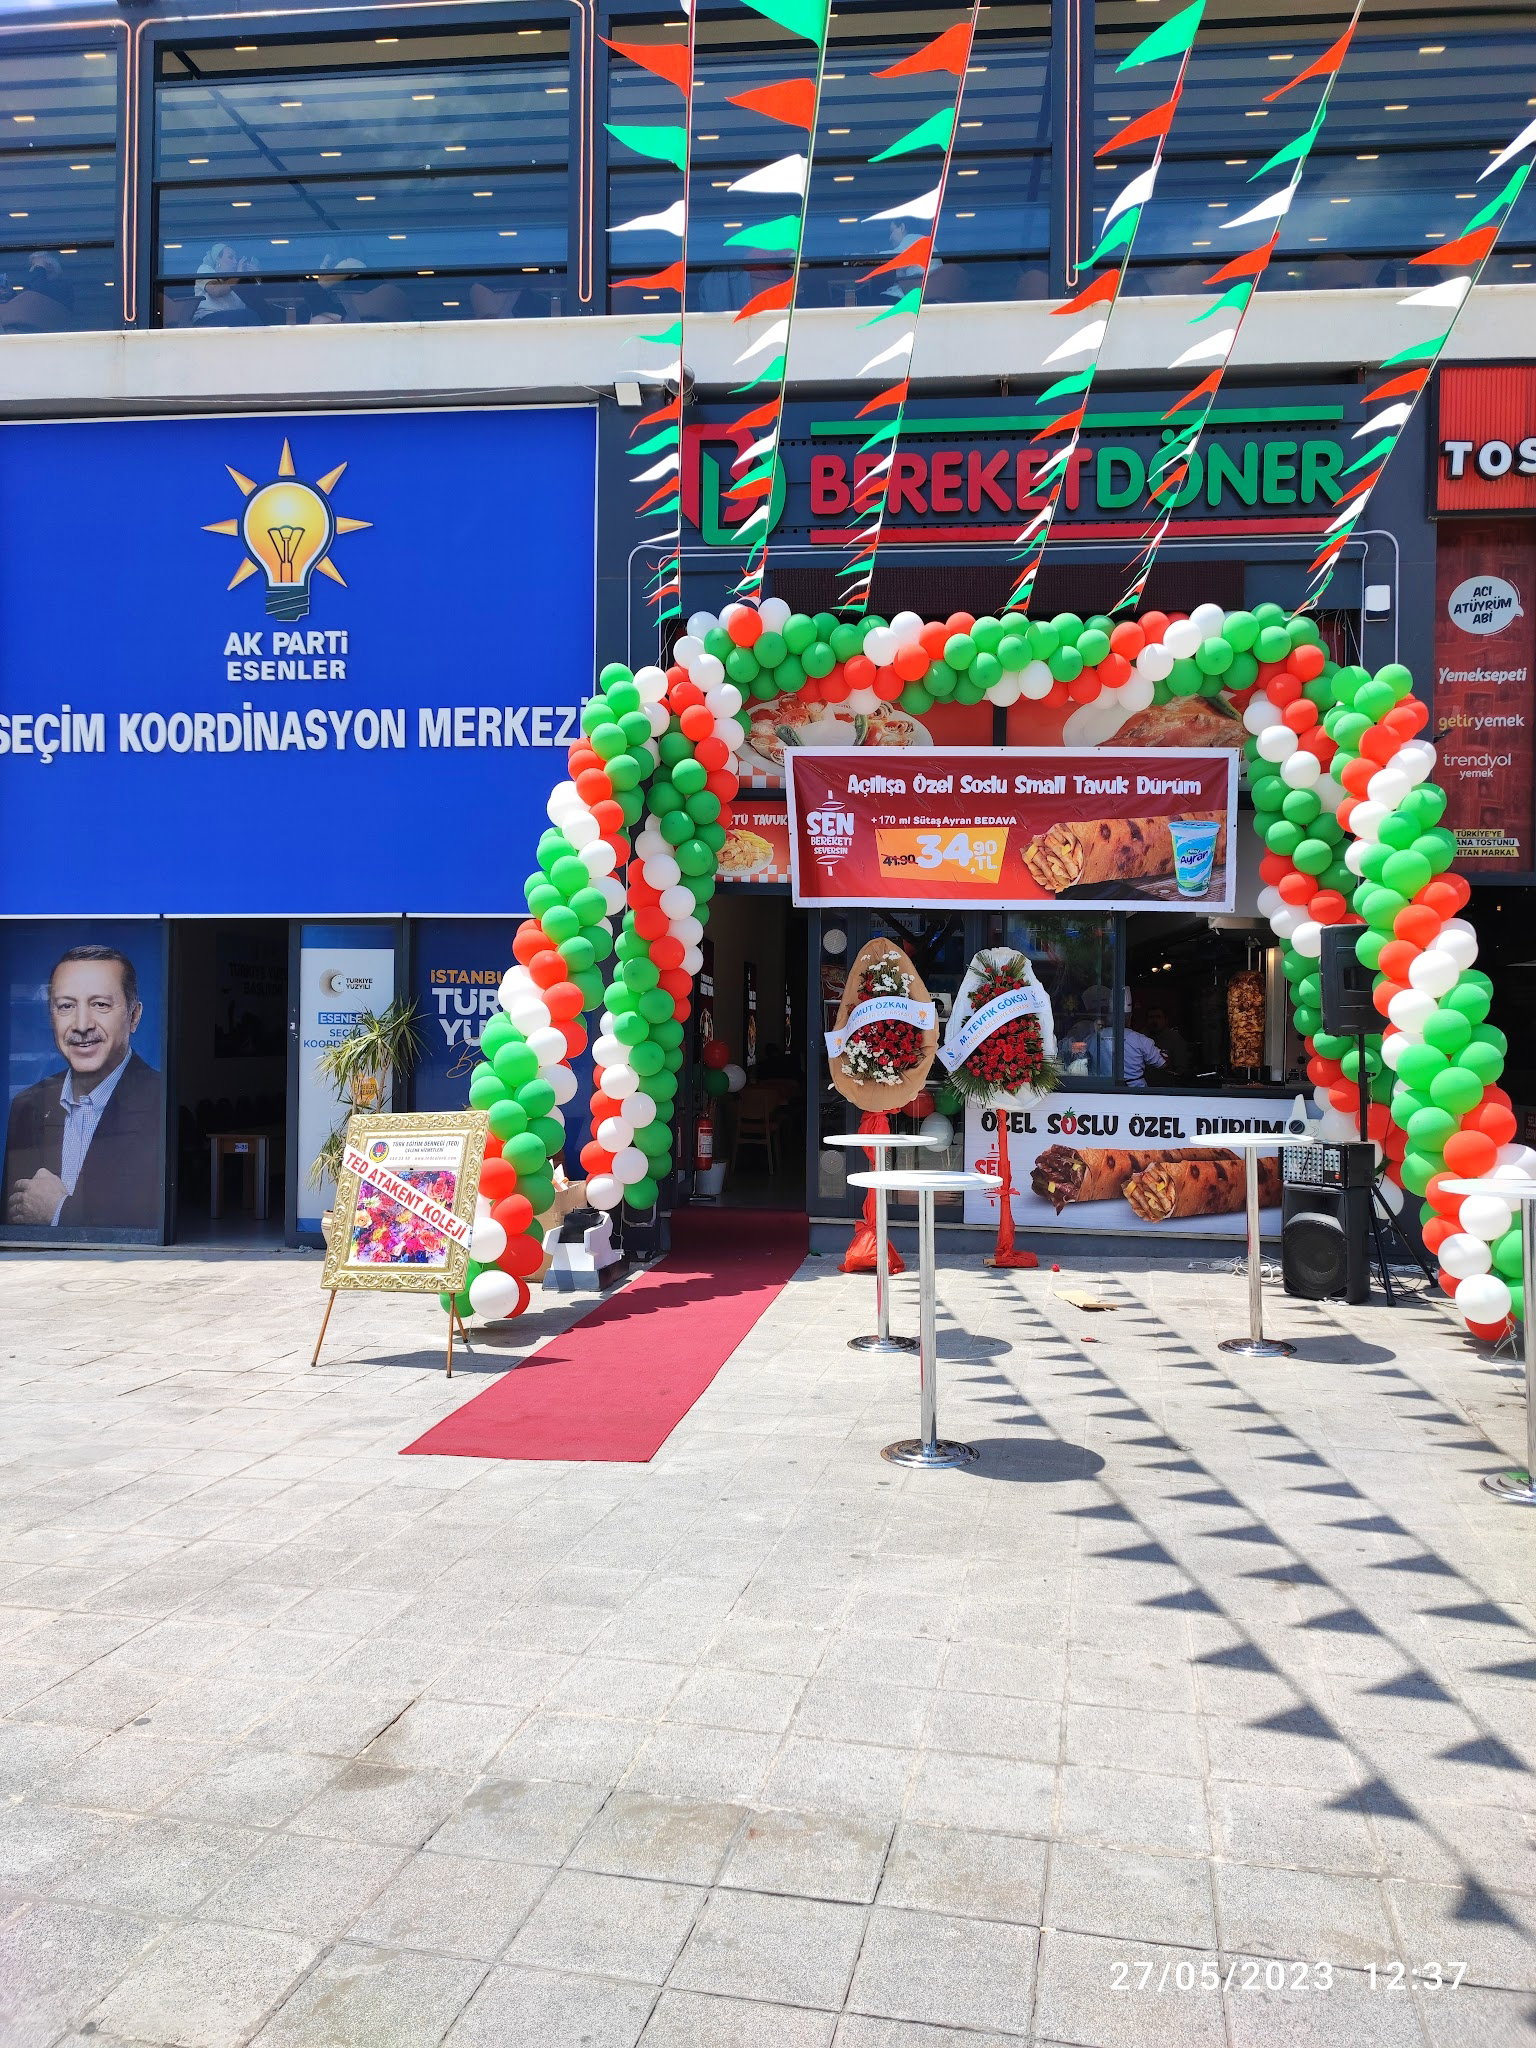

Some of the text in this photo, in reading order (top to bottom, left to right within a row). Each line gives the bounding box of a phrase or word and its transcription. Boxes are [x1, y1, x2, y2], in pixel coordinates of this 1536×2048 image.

[1473, 585, 1492, 598] ACI
[1453, 595, 1513, 615] ATÜYRÜM
[1472, 610, 1493, 625] ABİ
[223, 632, 263, 656] AK
[227, 659, 346, 681] ESENLER
[1438, 666, 1528, 685] Yemeksepeti
[119, 702, 405, 753] KOORDİNASYON
[1443, 752, 1512, 769] trendyol
[1460, 768, 1494, 781] yemek
[847, 772, 1202, 797] Açılışa Özel Soslu Small Tavuk Dürüm
[806, 811, 855, 836] SEN
[899, 816, 911, 825] ml
[974, 816, 1017, 825] BEDAVA
[1456, 829, 1502, 838] TÜRKİYE'YE
[1457, 838, 1515, 846] ANA TOSTUNU
[975, 856, 998, 870] TL
[875, 1001, 909, 1011] ÖZKAN
[320, 1013, 363, 1024] ESENLE
[960, 1035, 970, 1046] M.
[967, 1006, 998, 1034] TEVFİK
[997, 993, 1028, 1011] GÖKSU
[981, 1108, 1287, 1139] ÖEL SOSLU ÖZEL DÜRÜM
[975, 1159, 1000, 1177] SE
[346, 1152, 469, 1241] TED ATAKENT KOLEJİ
